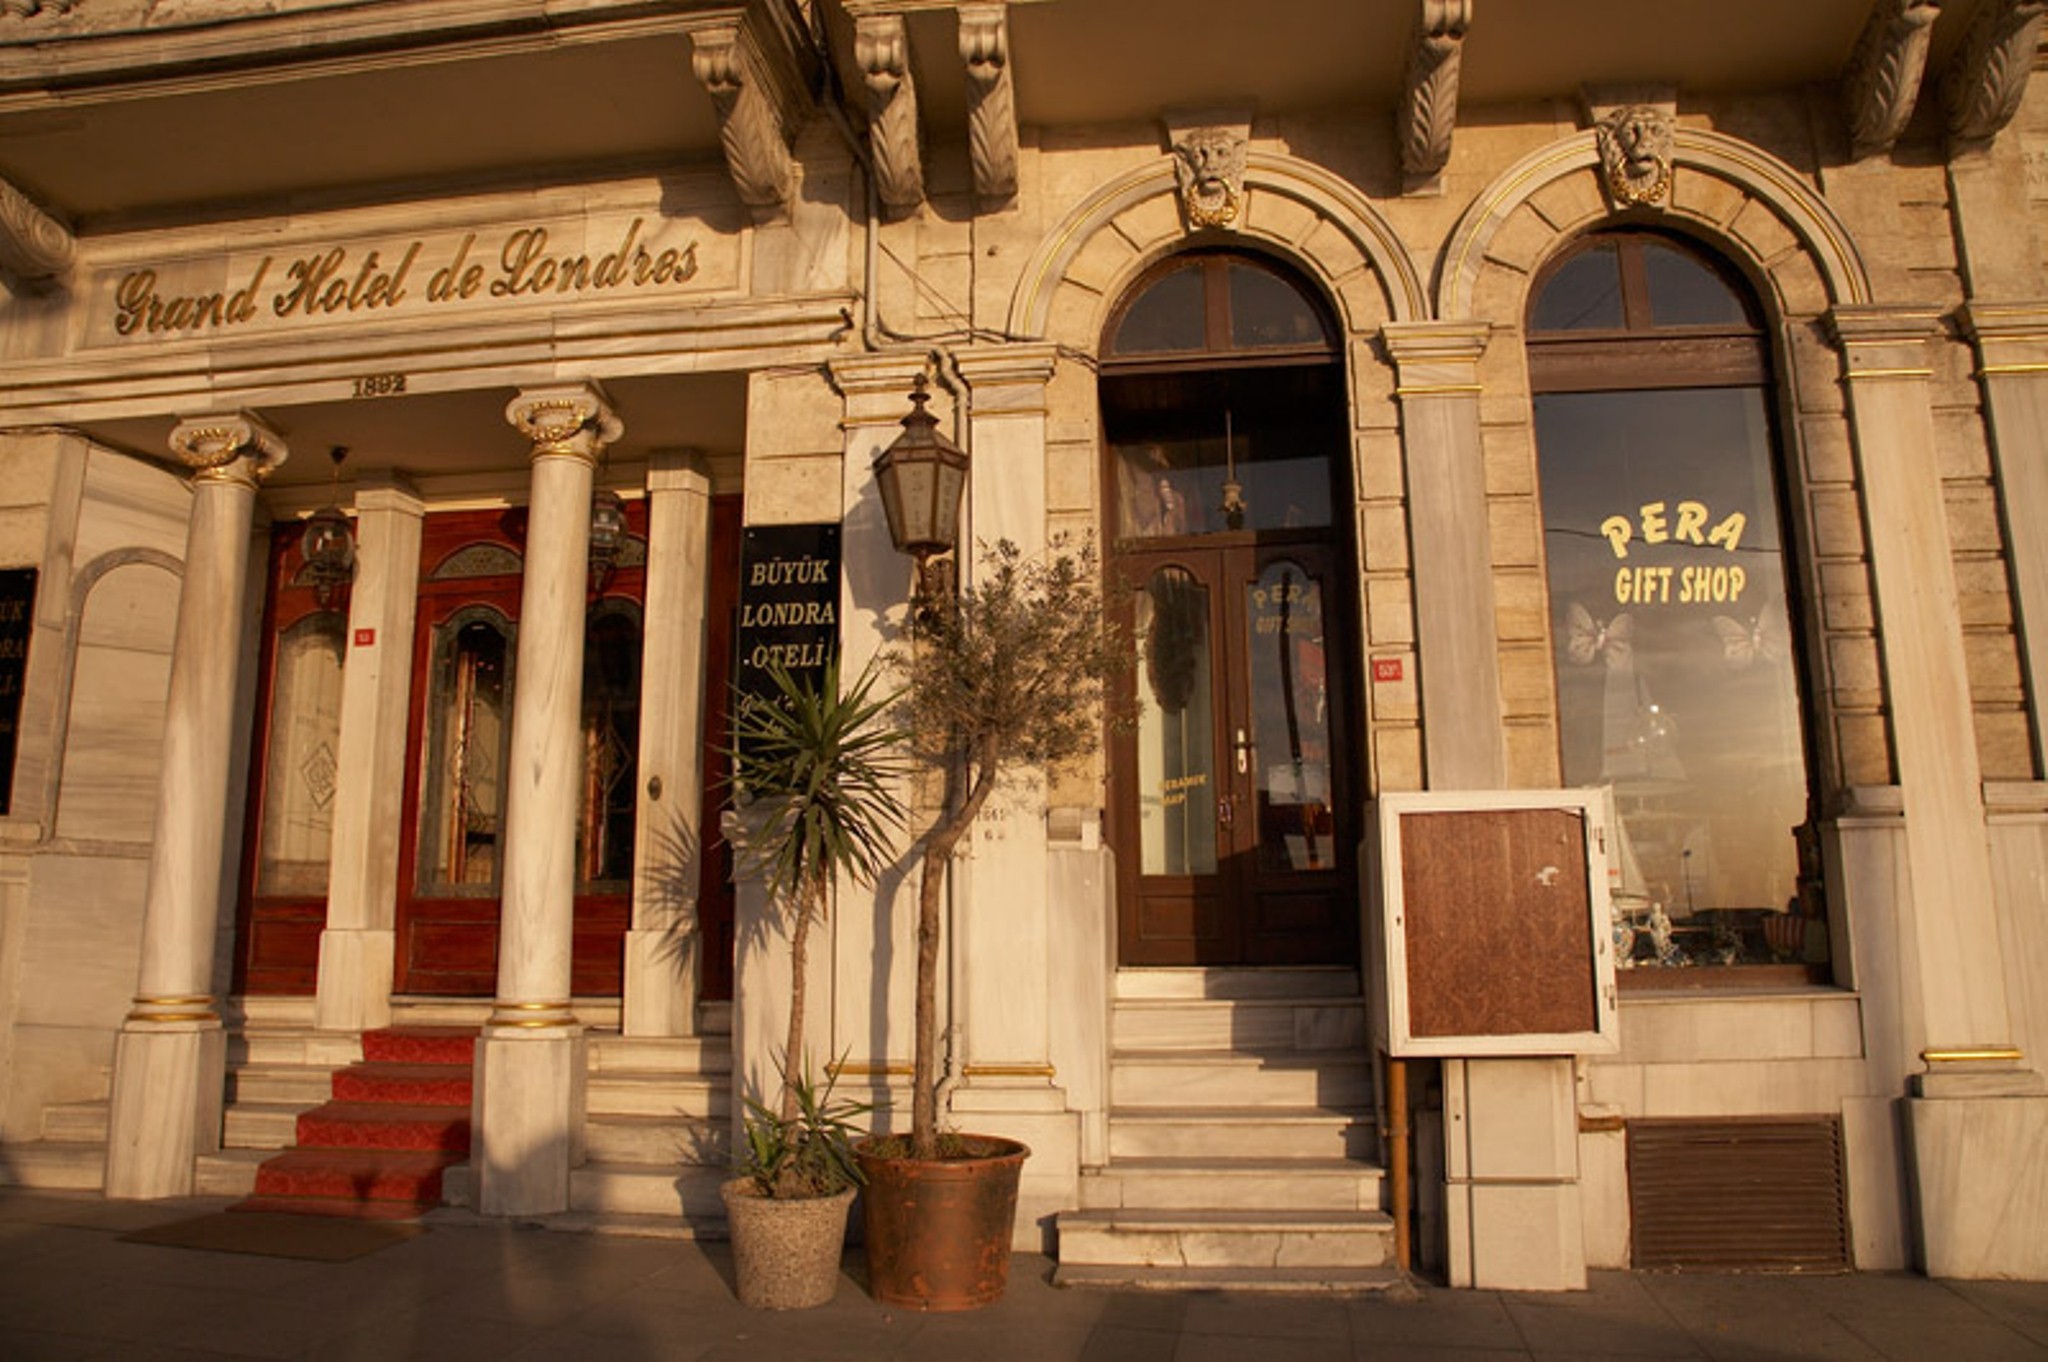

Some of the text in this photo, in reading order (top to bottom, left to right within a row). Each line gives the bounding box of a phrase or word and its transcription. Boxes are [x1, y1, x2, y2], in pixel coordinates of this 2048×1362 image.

[114, 216, 699, 336] Grand Hotel de Londres
[352, 372, 407, 398] 1892
[1601, 501, 1746, 558] PERA
[751, 554, 829, 586] BÜYÜK
[1616, 566, 1746, 603] GIFT SHOP
[741, 601, 836, 627] LONDRA
